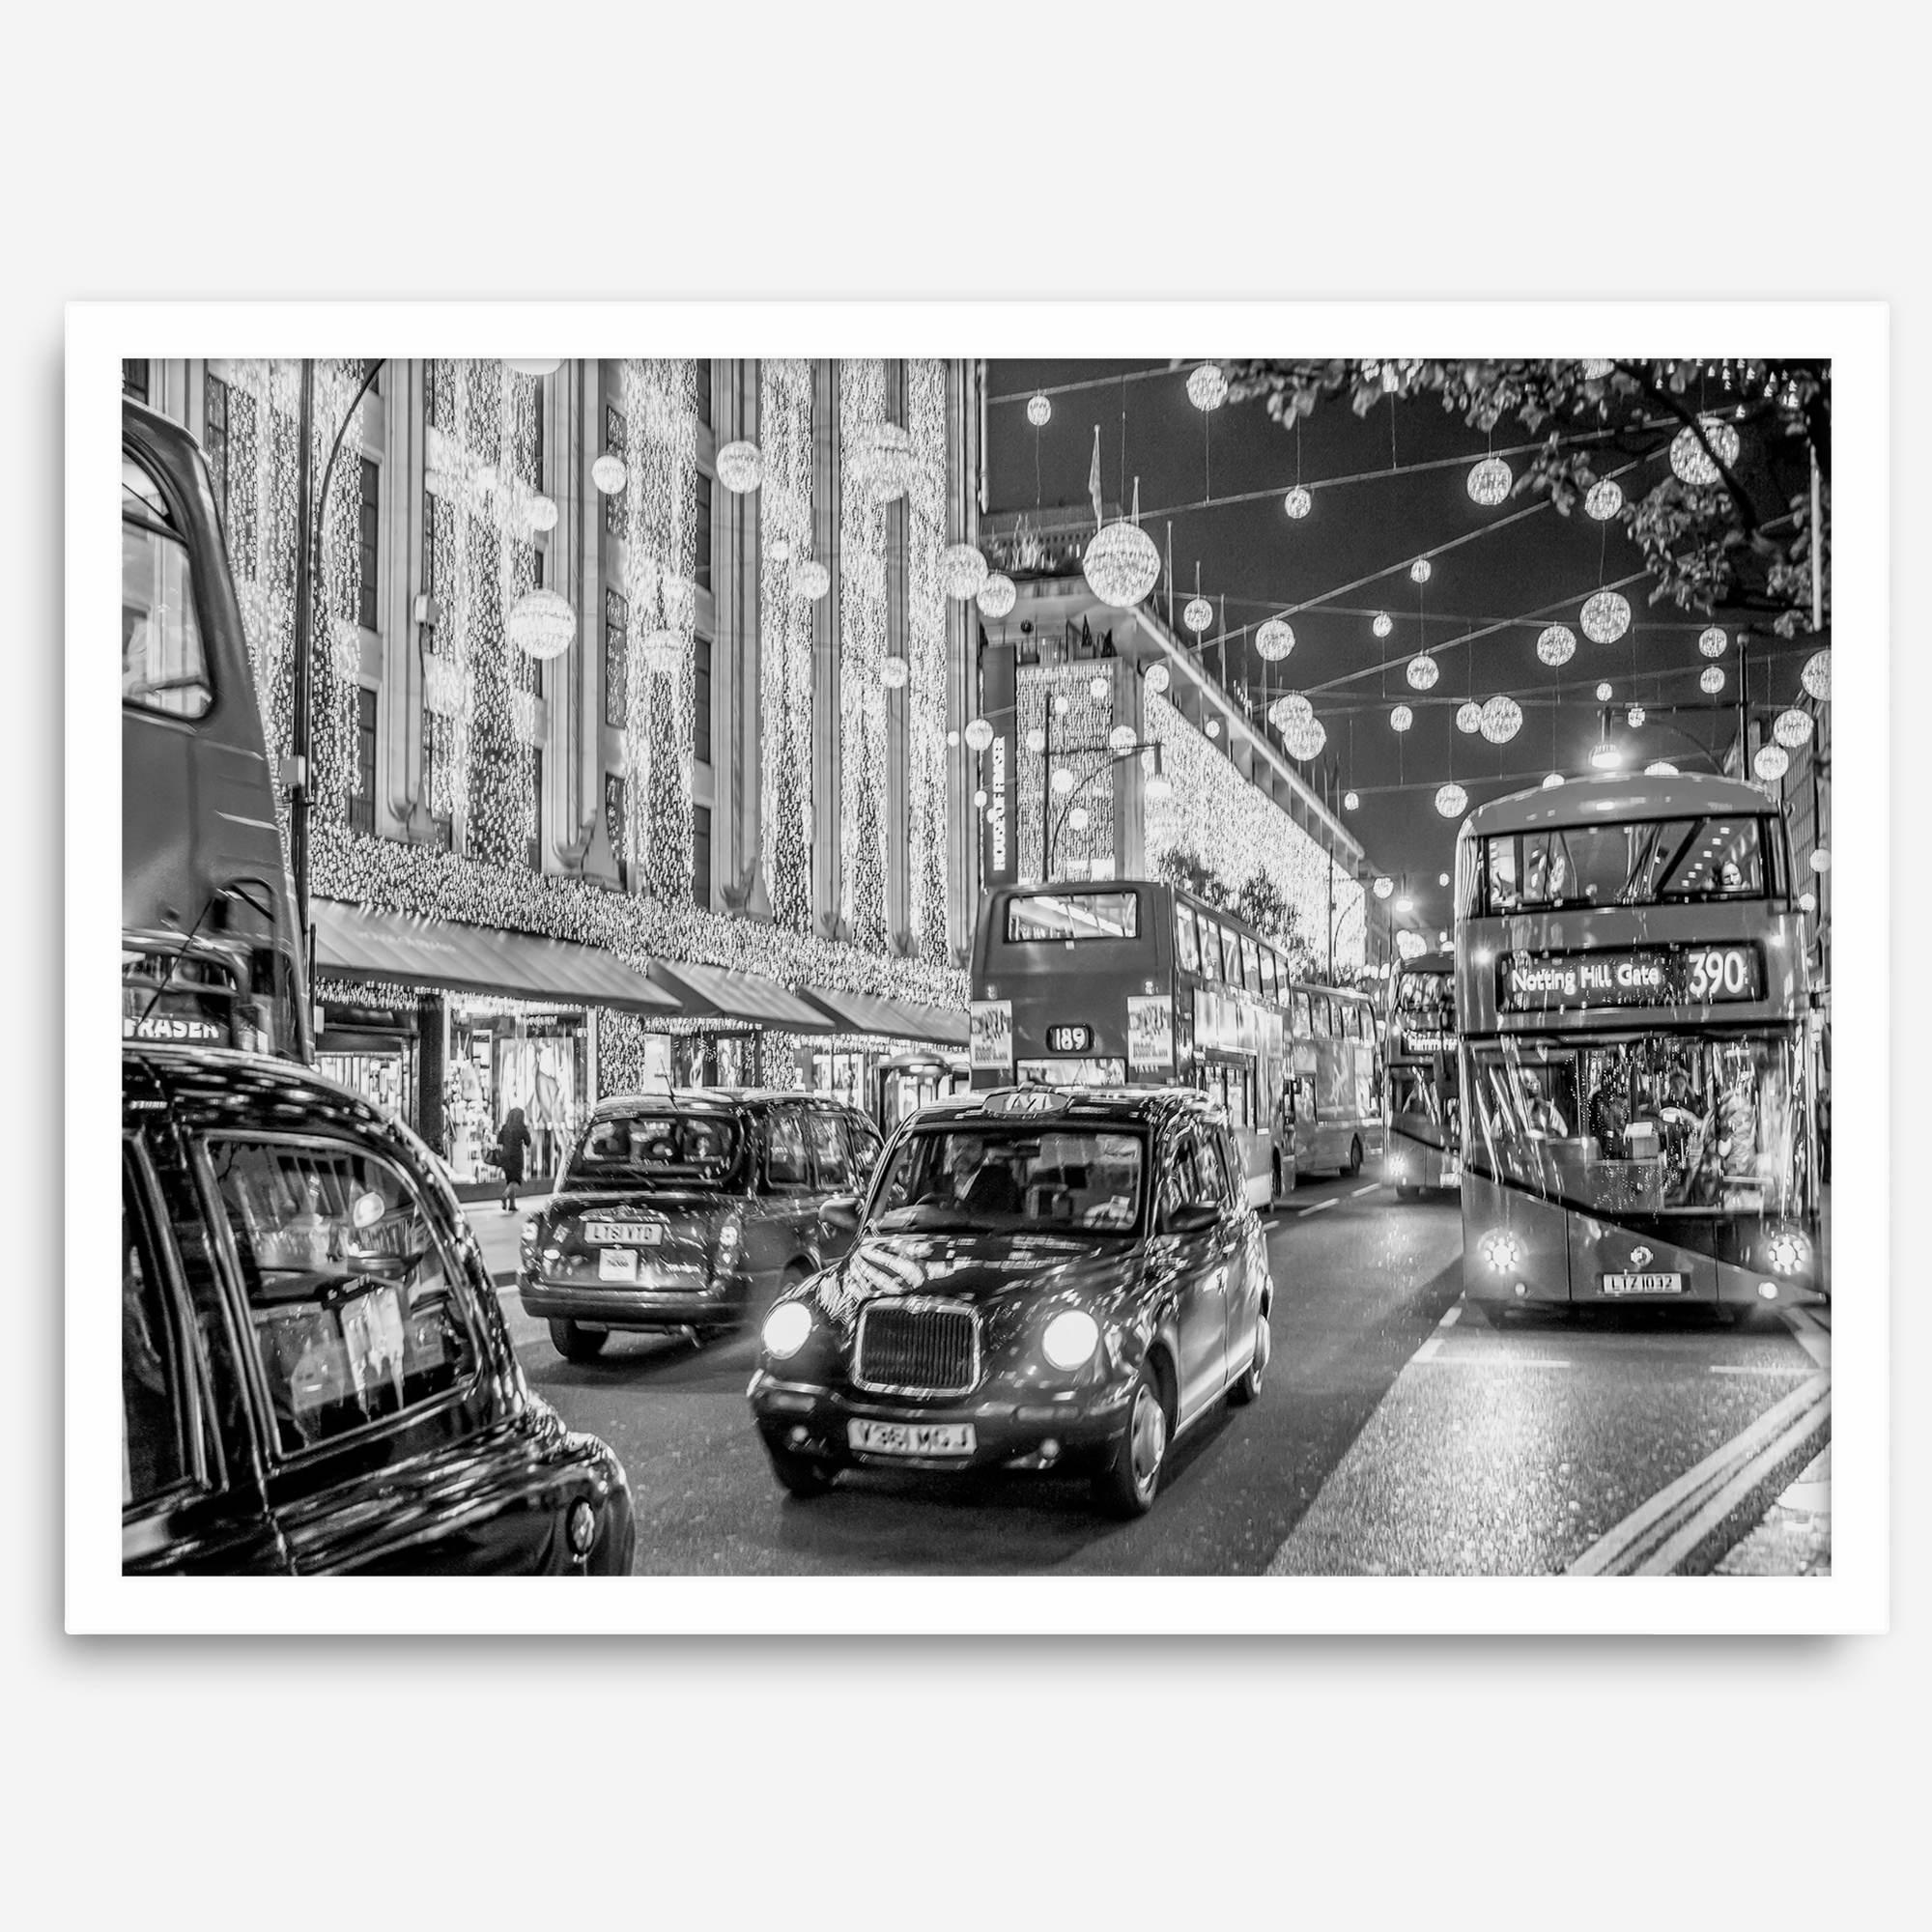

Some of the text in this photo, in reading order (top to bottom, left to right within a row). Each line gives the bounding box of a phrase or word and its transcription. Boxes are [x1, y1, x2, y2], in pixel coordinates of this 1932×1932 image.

[992, 736, 1006, 871] HOUSE OF FRASER
[1511, 951, 1745, 995] Notting Hill Gate 390
[1056, 1027, 1086, 1051] 189
